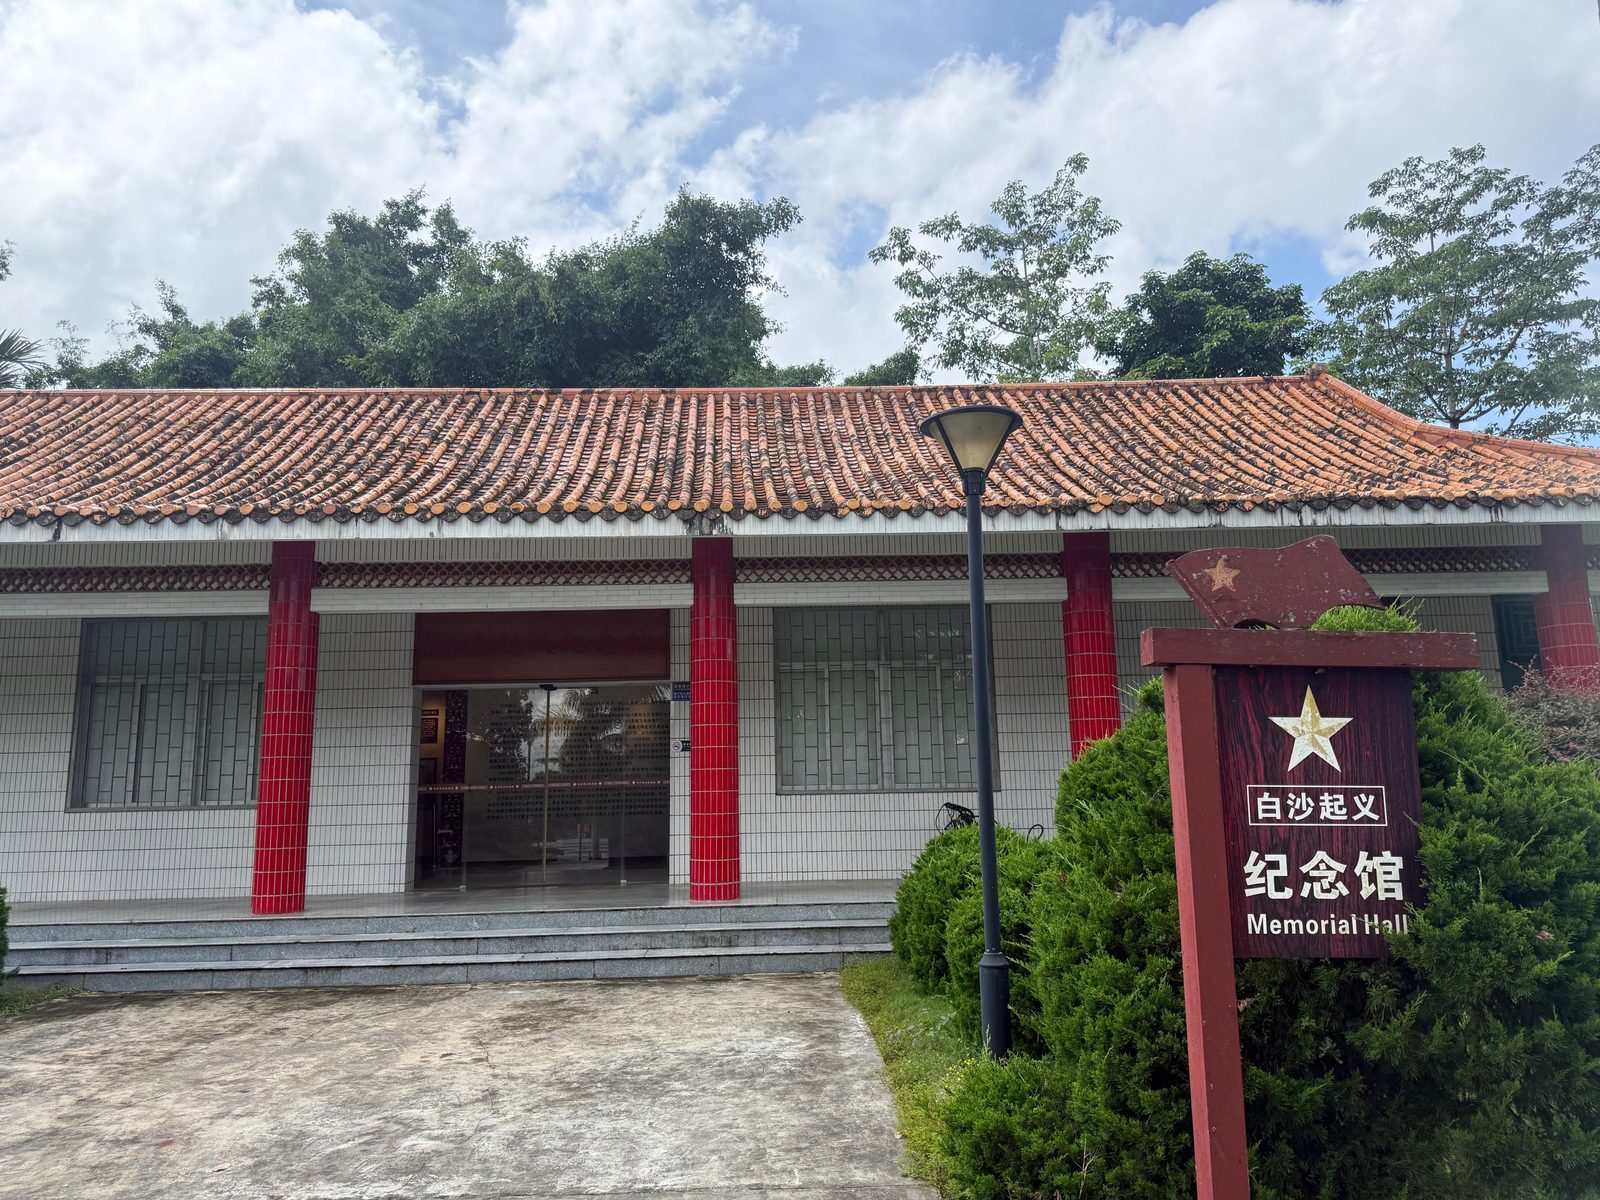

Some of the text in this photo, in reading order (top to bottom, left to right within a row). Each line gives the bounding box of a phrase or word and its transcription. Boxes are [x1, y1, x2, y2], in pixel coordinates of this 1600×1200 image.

[1256, 792, 1380, 821] 白沙起义
[1243, 850, 1404, 901] 纪念馆
[1247, 913, 1408, 935] Memorial Hall
